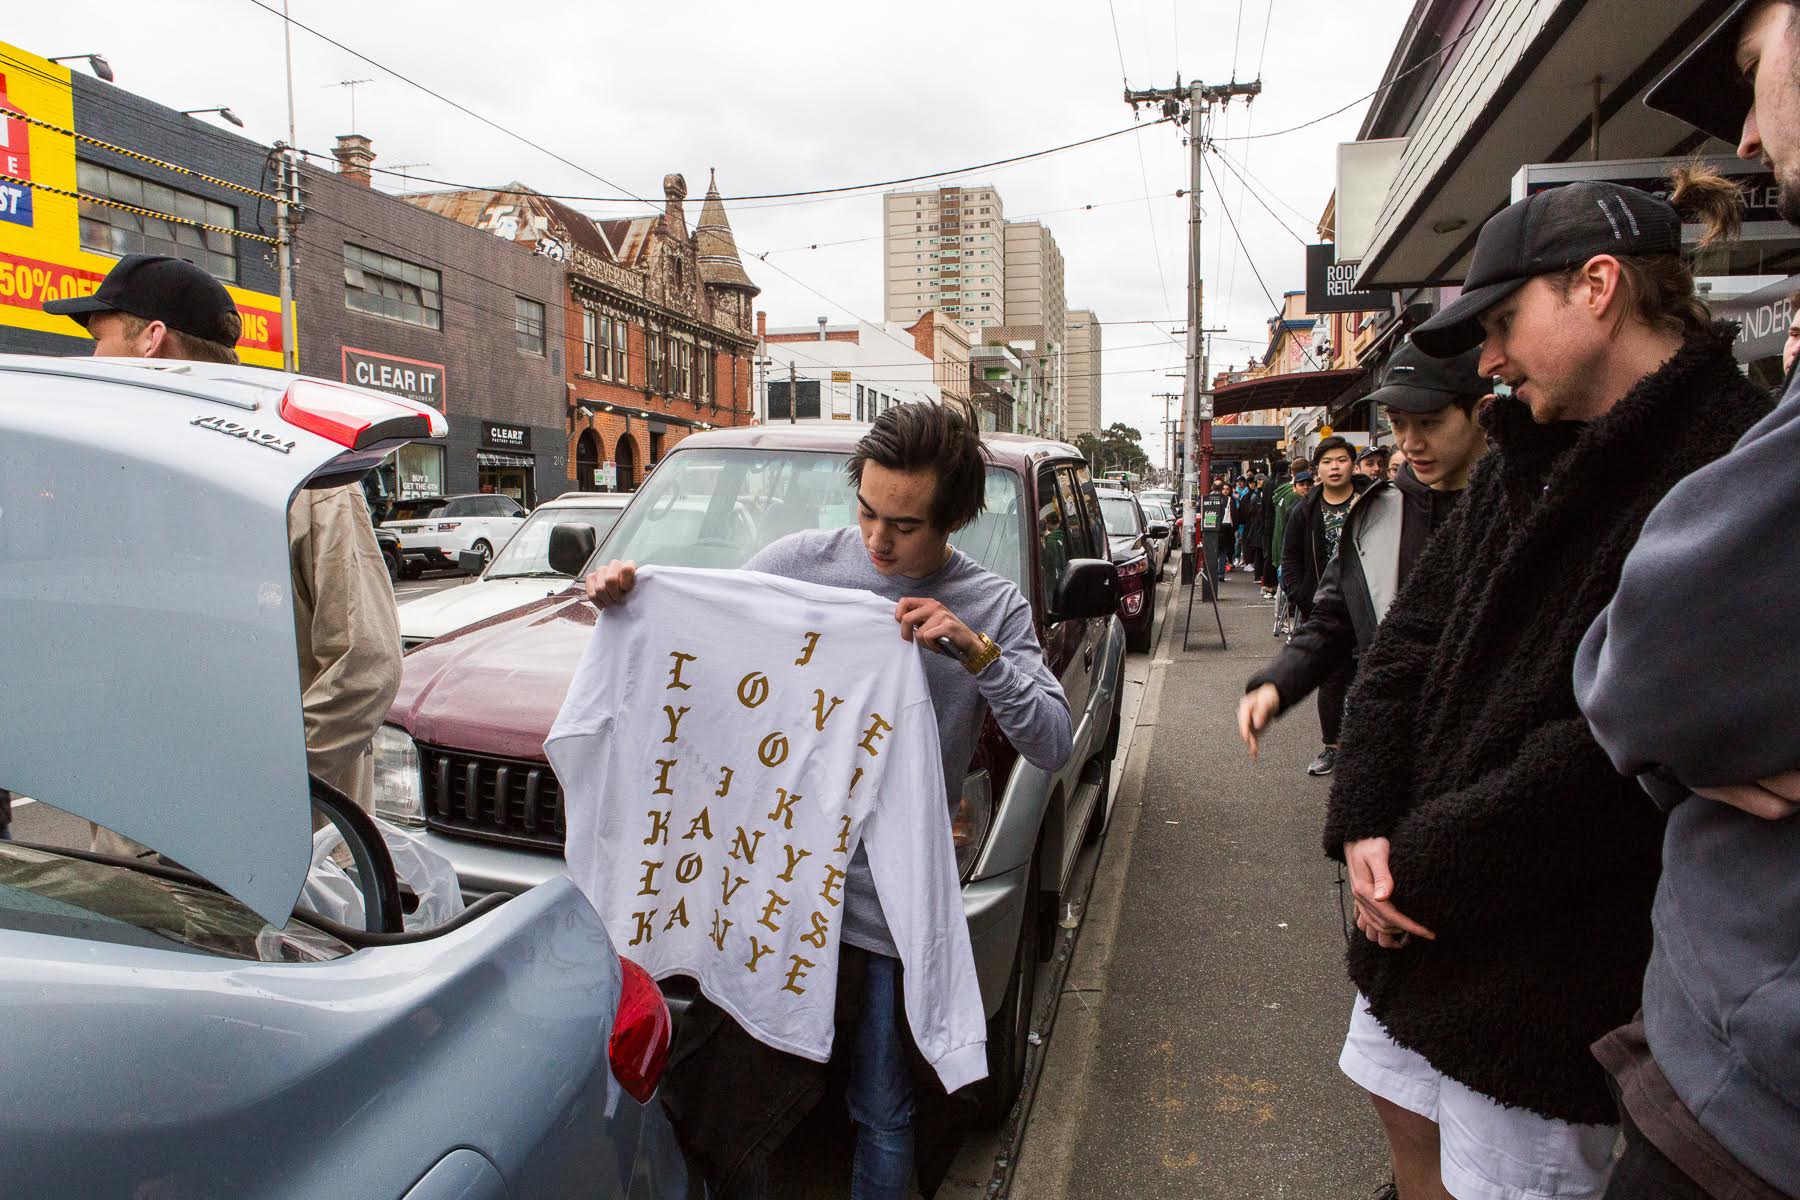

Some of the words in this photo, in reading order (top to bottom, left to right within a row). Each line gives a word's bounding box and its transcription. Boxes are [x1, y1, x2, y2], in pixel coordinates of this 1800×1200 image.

[1327, 280, 1370, 296] RETU
[1730, 298, 1792, 345] ANDER
[356, 362, 416, 391] CLEAR
[421, 373, 435, 393] IT
[190, 415, 296, 454] TOYOTA
